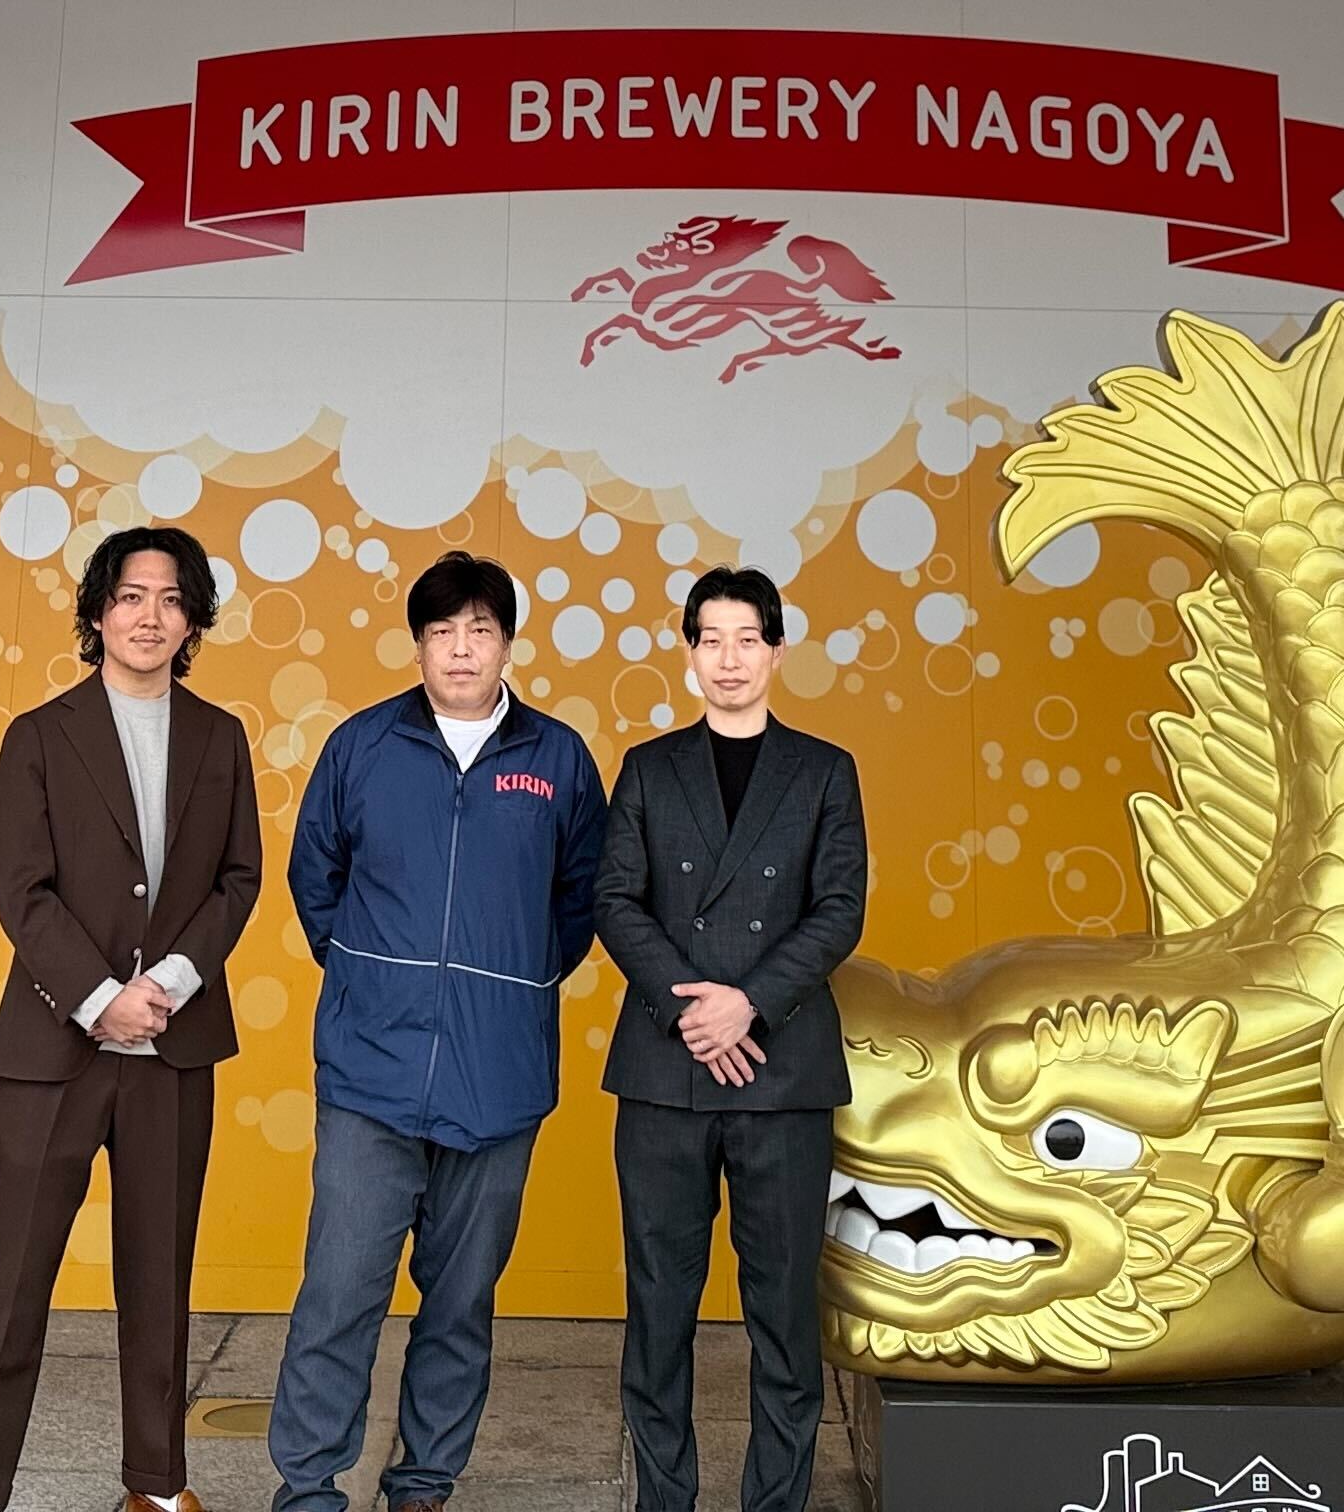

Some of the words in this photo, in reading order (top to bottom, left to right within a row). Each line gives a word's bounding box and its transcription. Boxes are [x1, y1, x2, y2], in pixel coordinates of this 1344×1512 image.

[239, 85, 458, 169] KIRIN
[509, 75, 876, 142] BREWERY
[916, 84, 1235, 183] NAGOYA
[495, 773, 554, 801] KIRIN
